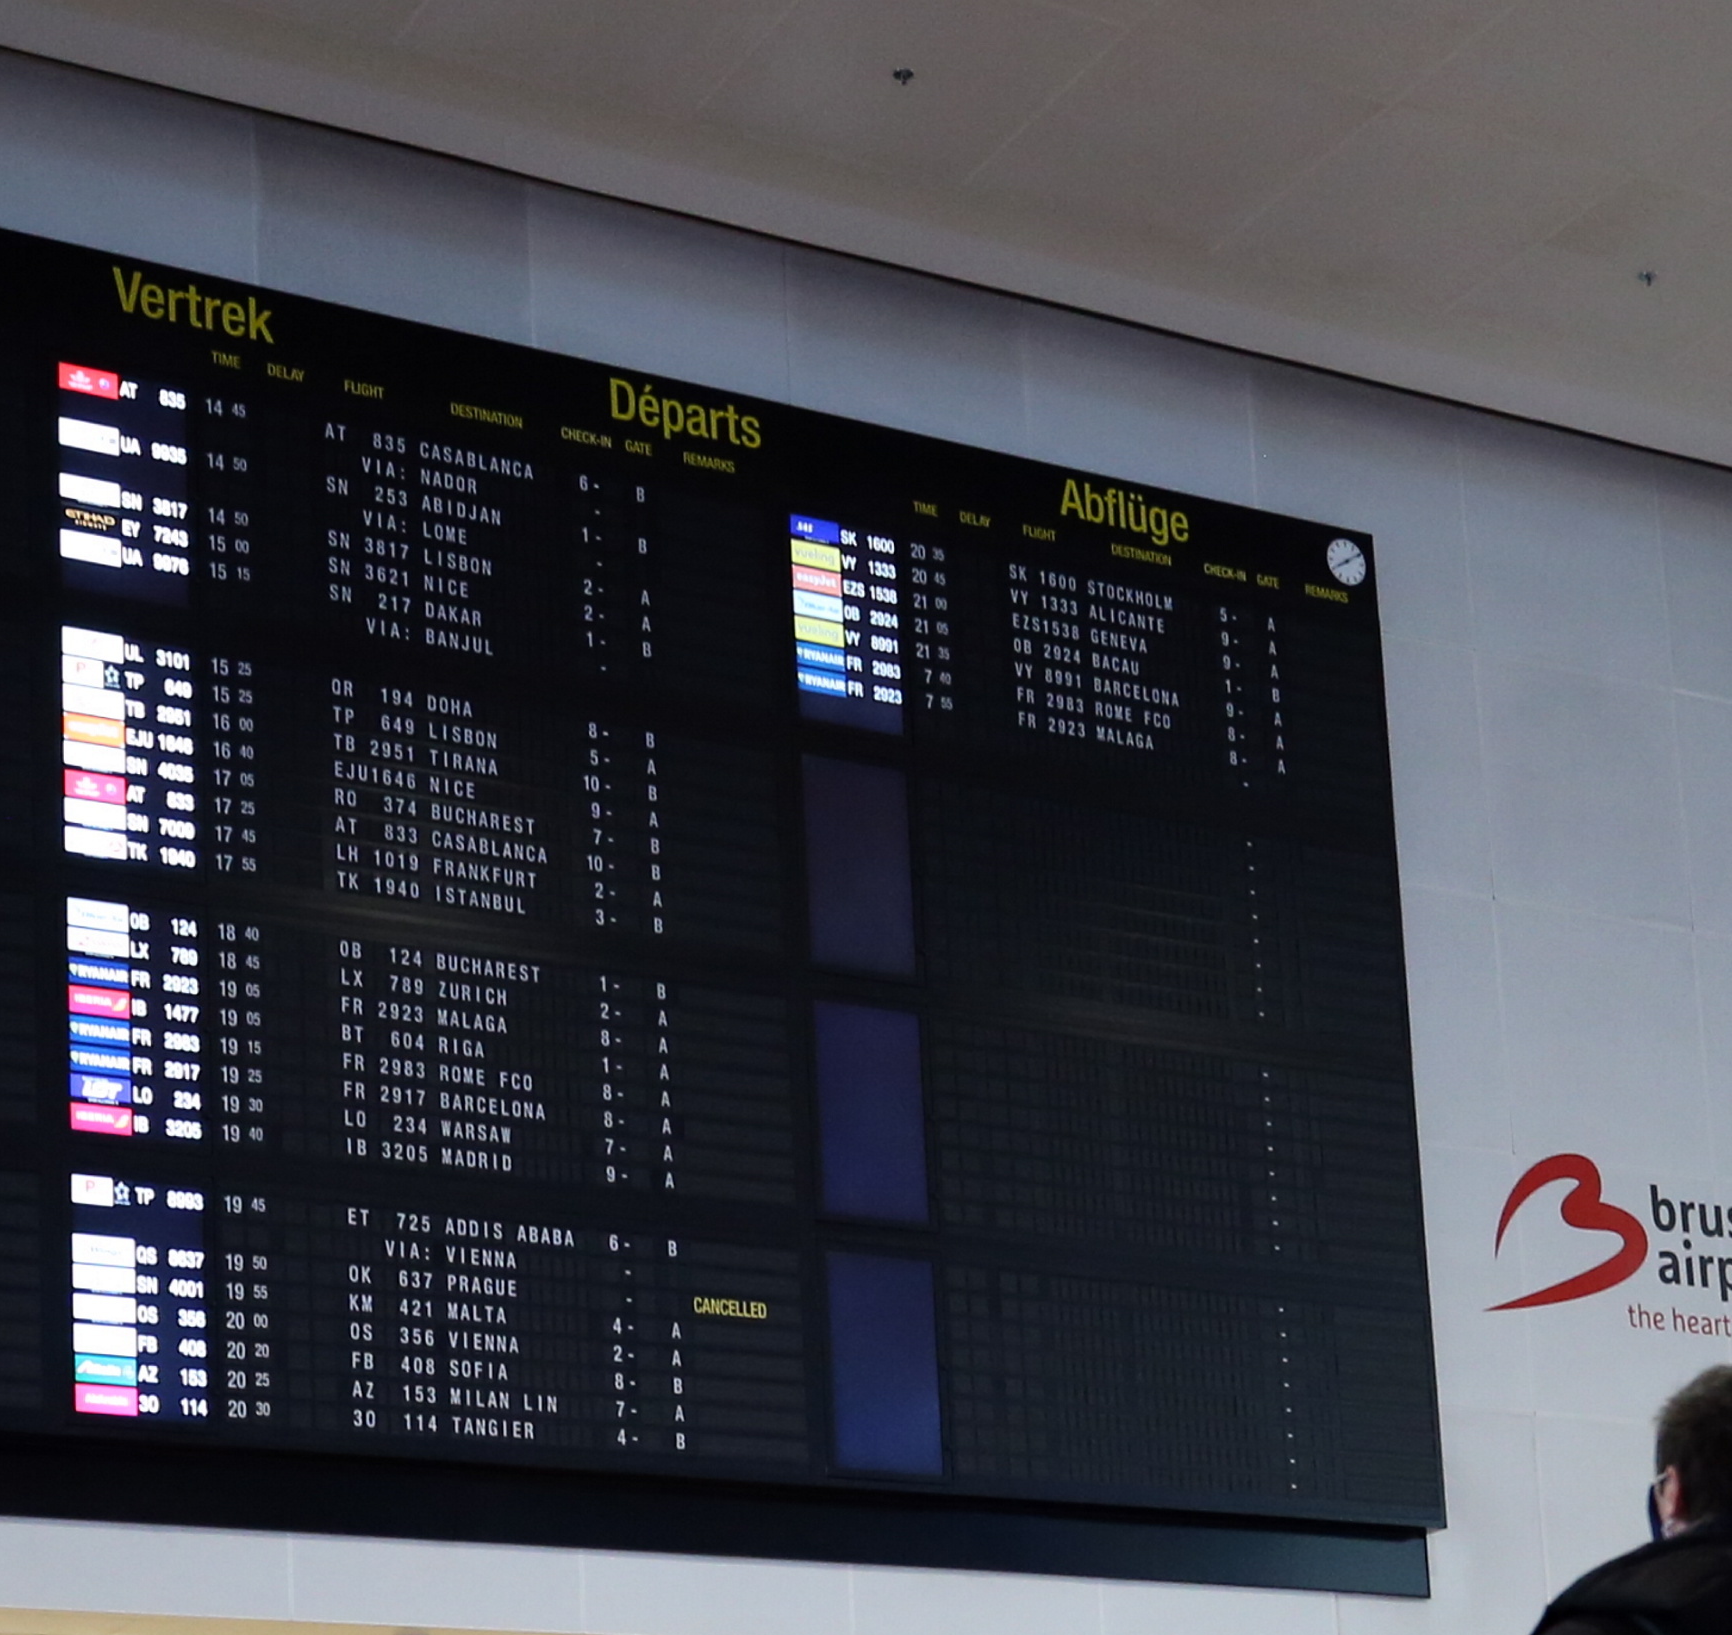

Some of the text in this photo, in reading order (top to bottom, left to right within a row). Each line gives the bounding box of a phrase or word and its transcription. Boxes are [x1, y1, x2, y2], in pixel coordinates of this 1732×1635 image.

[112, 266, 275, 344] Vertrek
[211, 350, 736, 474] TIME DELAY FLIGHT DESTINATION CHECK-IN GATE REMARKS
[609, 377, 762, 449] Départs
[419, 441, 534, 480] CASABLANCA
[420, 468, 477, 495] NADOR
[65, 508, 116, 526] ETIHAD
[421, 494, 501, 526] ABIDJAN
[1060, 478, 1189, 547] Abflüge
[422, 521, 467, 545] LOME
[424, 548, 492, 577] LISBON
[913, 500, 1349, 604] TIME DELAY FLIGHT DESTINATION CHECK-IN GATE REMARKS
[424, 574, 469, 599] NICE
[1087, 579, 1173, 611] STOCKHOLM
[424, 601, 482, 627] DAKAR
[1089, 604, 1165, 634] ALICANTE
[425, 627, 493, 656] BANJUL
[1090, 628, 1148, 654] GENEVA
[805, 650, 845, 666] RYANAIR
[1092, 652, 1139, 676] BACAU
[806, 676, 846, 692] RYANAIR
[1093, 676, 1179, 707] BARCELONA
[427, 694, 472, 718] DOHA
[1094, 701, 1171, 729] ROME FCO
[1096, 725, 1154, 751] MALAGA
[429, 748, 498, 776] TIRANA
[431, 803, 535, 835] BUCHAREST
[436, 952, 540, 983] BUCHAREST
[438, 980, 507, 1006] ZURICH
[437, 1007, 507, 1034] MALAGA
[438, 1036, 485, 1058] RIGA
[440, 1092, 546, 1121] BARCELONA
[440, 1119, 511, 1144] WARSAW
[441, 1147, 512, 1172] MADRID
[445, 1217, 575, 1247] ADDIS ABABA
[445, 1245, 517, 1270] VIENNA
[447, 1273, 768, 1320] PRAGUE CANCELLED
[447, 1301, 507, 1325] MALTA
[1628, 1304, 1665, 1331] the
[1672, 1307, 1732, 1338] heart
[449, 1358, 508, 1381] SOFIA
[449, 1386, 558, 1414] MILAN LIN
[451, 1416, 534, 1440] TANGIER
